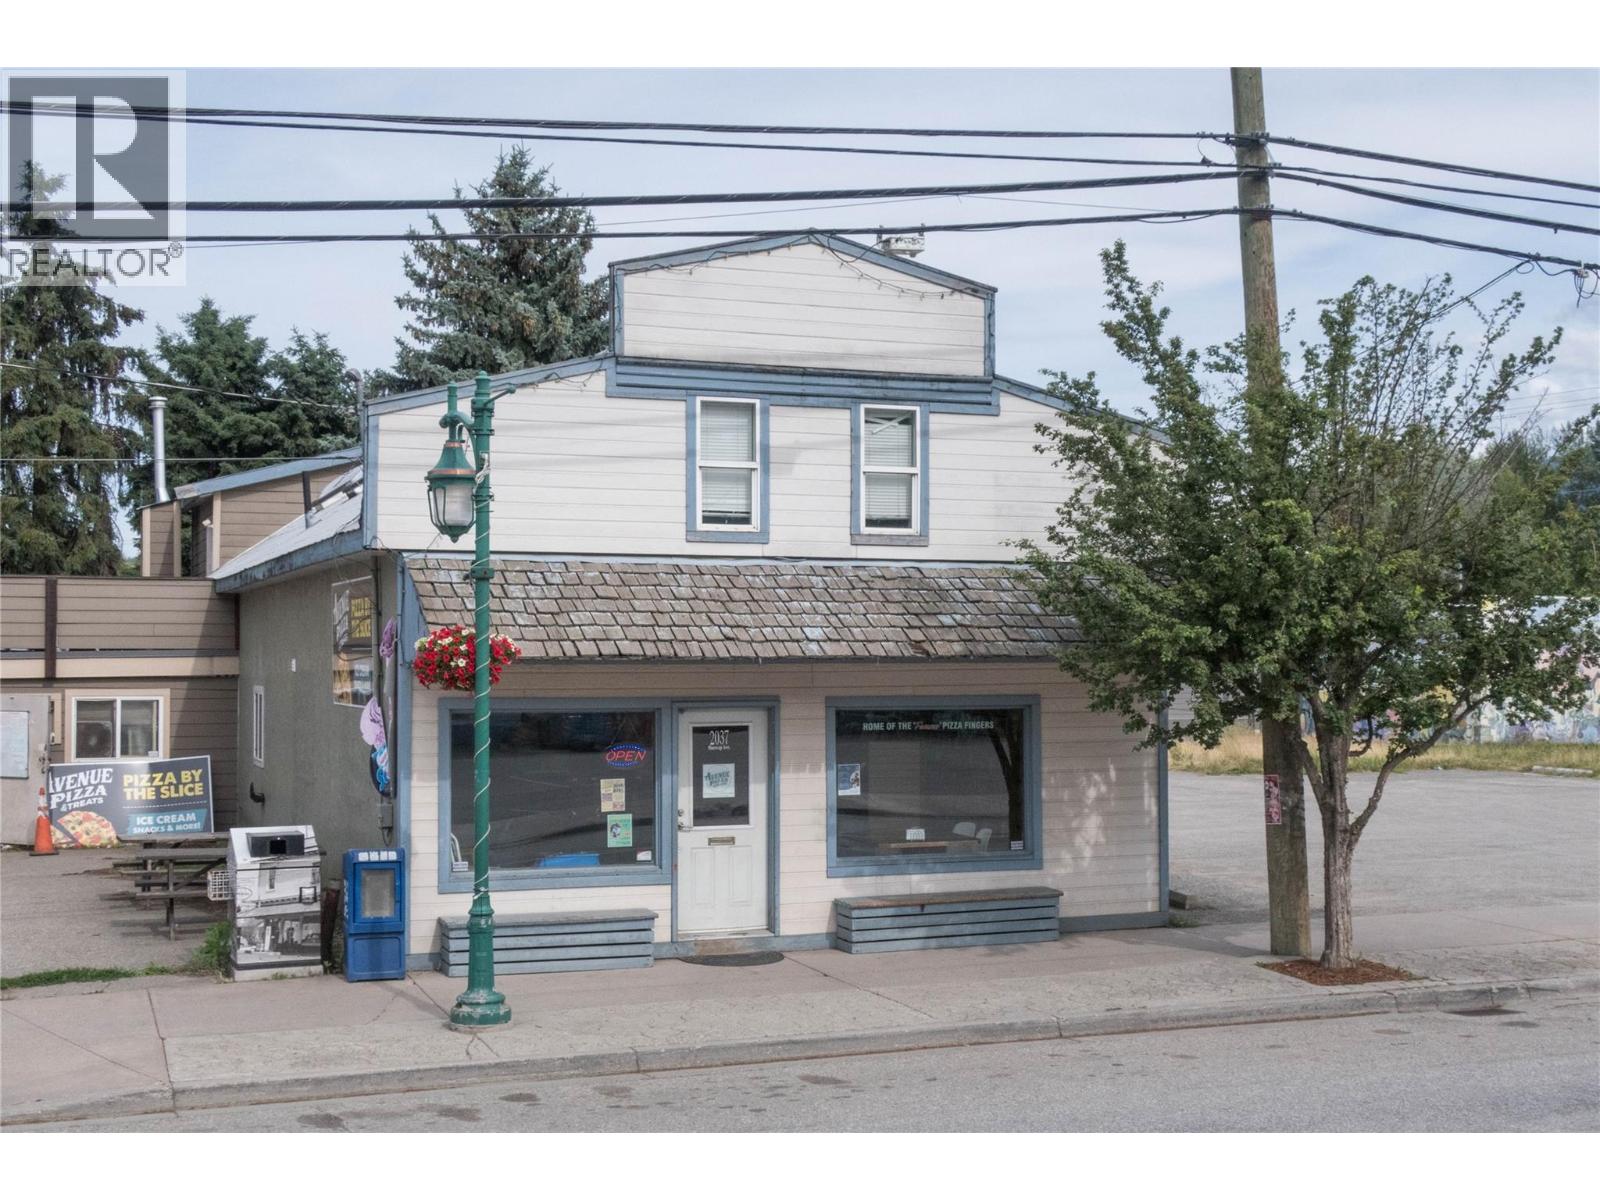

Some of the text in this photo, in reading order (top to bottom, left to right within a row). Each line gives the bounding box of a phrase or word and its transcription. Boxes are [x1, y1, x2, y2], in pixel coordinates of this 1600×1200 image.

[862, 721, 885, 731] HOME
[886, 721, 897, 731] OF
[898, 720, 913, 730] THE
[942, 719, 962, 730] PIZZA
[964, 719, 994, 730] FINGERS
[708, 729, 730, 746] 2037
[604, 749, 647, 762] OPEN
[122, 768, 203, 787] PIZZA BY
[50, 784, 107, 810] PIZZA
[122, 782, 204, 801] THE SLICE
[136, 812, 197, 826] ICE CREAM
